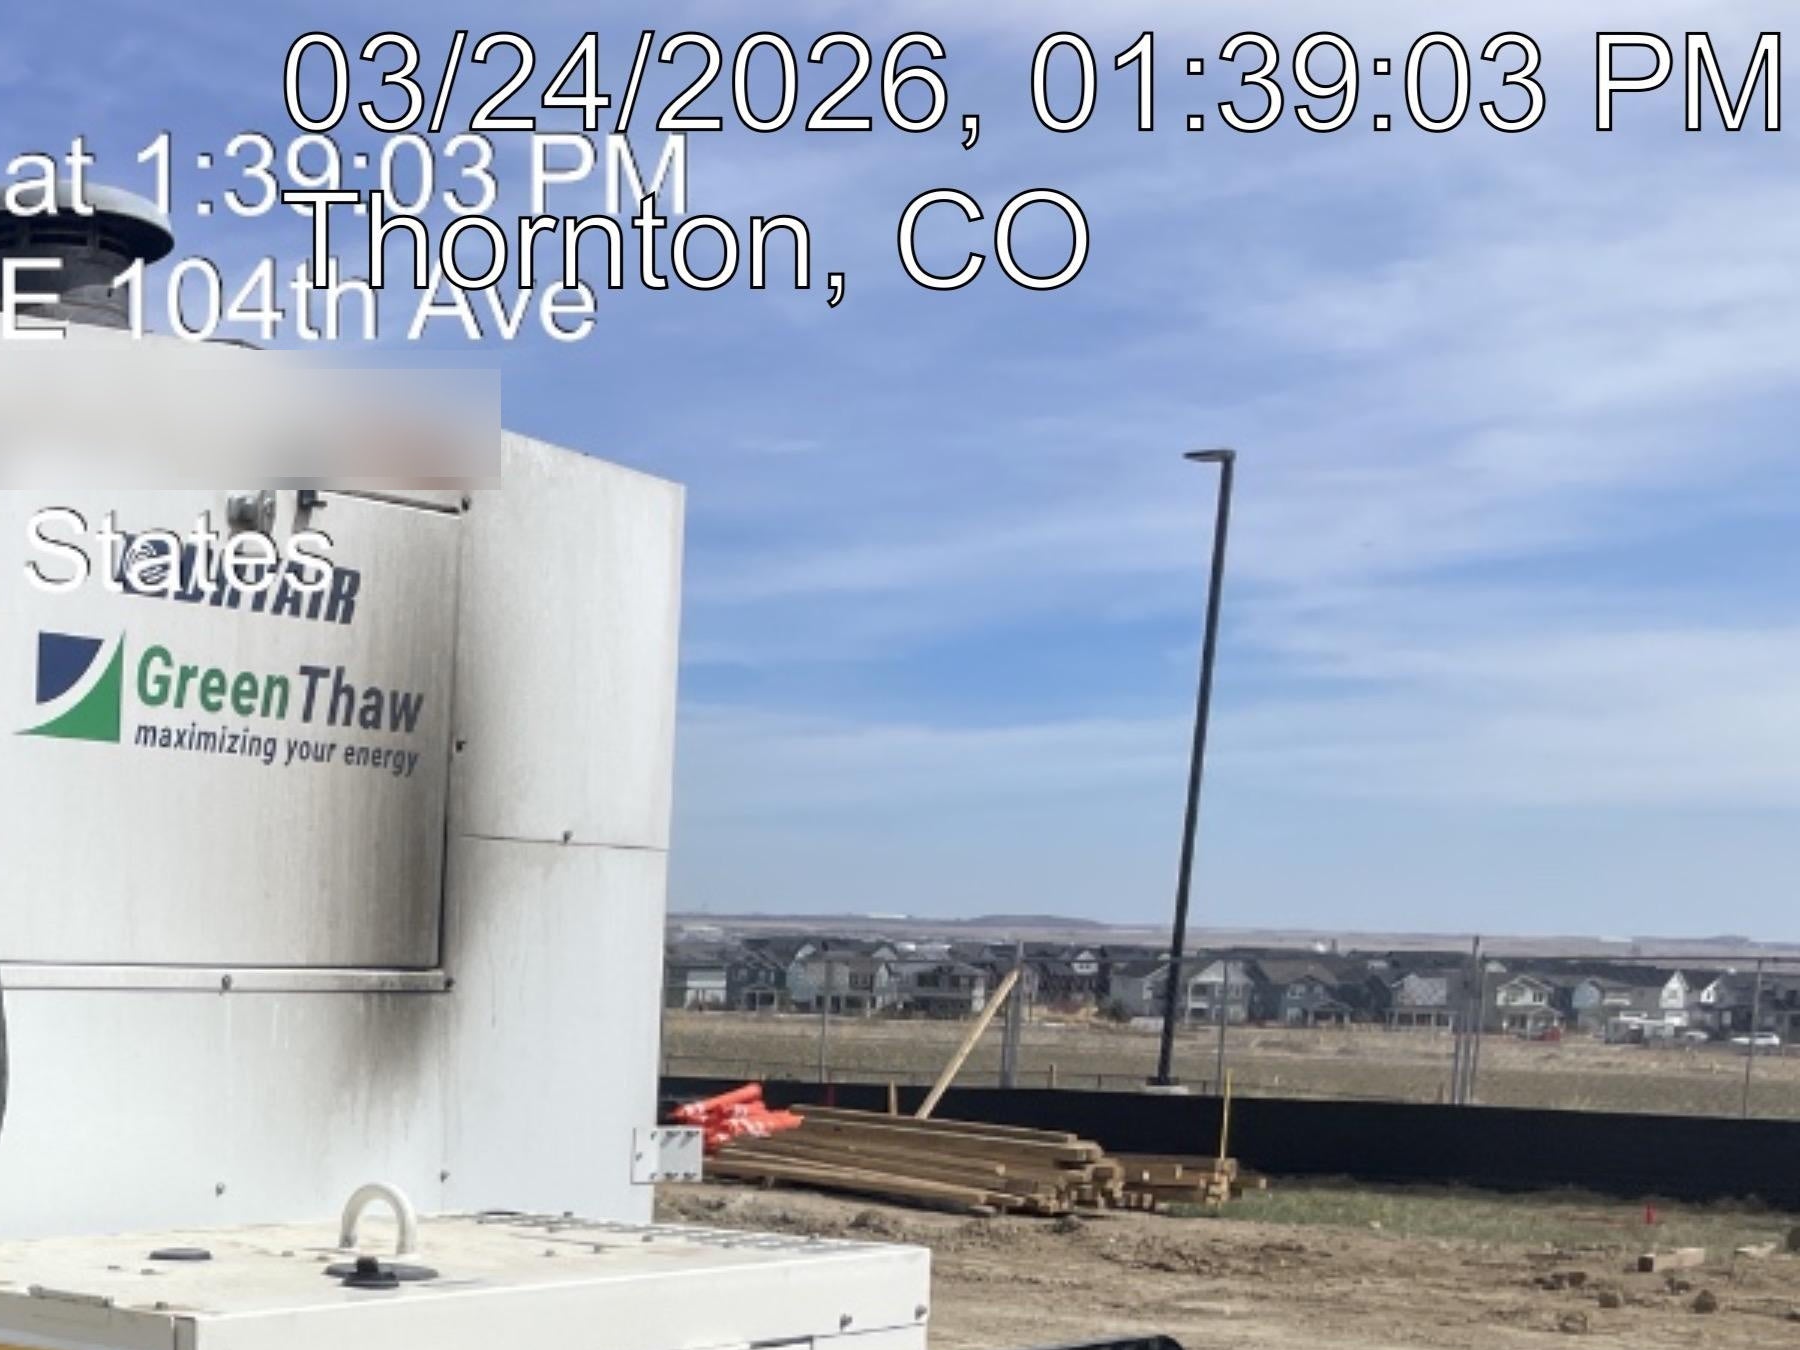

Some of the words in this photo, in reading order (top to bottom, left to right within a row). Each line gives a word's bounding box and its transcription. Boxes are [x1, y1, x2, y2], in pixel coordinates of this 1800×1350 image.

[134, 720, 277, 766] maximizing
[284, 736, 337, 767] your
[343, 743, 420, 778] energy
